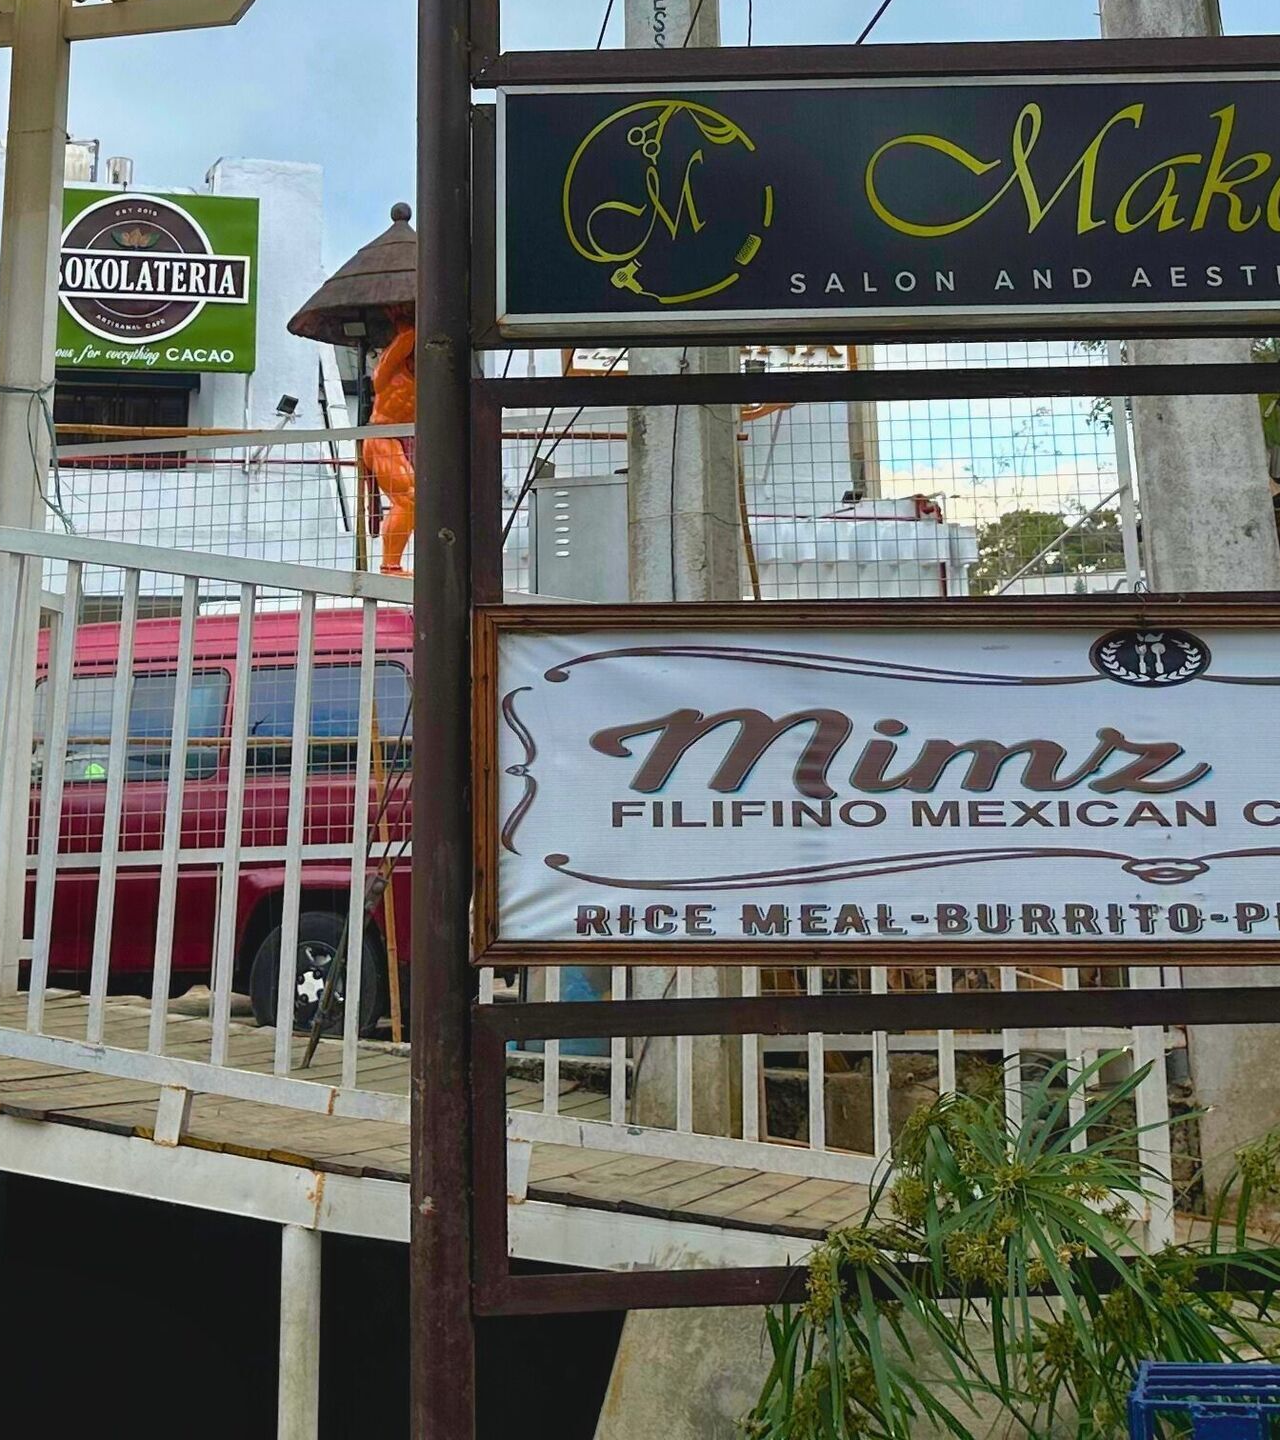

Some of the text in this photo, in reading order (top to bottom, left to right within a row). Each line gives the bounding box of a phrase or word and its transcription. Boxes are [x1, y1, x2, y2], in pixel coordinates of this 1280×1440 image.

[789, 269, 958, 296] SALON
[995, 267, 1096, 293] AND
[73, 344, 101, 364] for
[106, 345, 160, 366] everything
[166, 347, 235, 363] CACAO
[589, 707, 1213, 799] Mimz
[611, 799, 887, 828] FILIFINO
[911, 799, 1217, 828] MEXICAN
[574, 902, 719, 938] RICE
